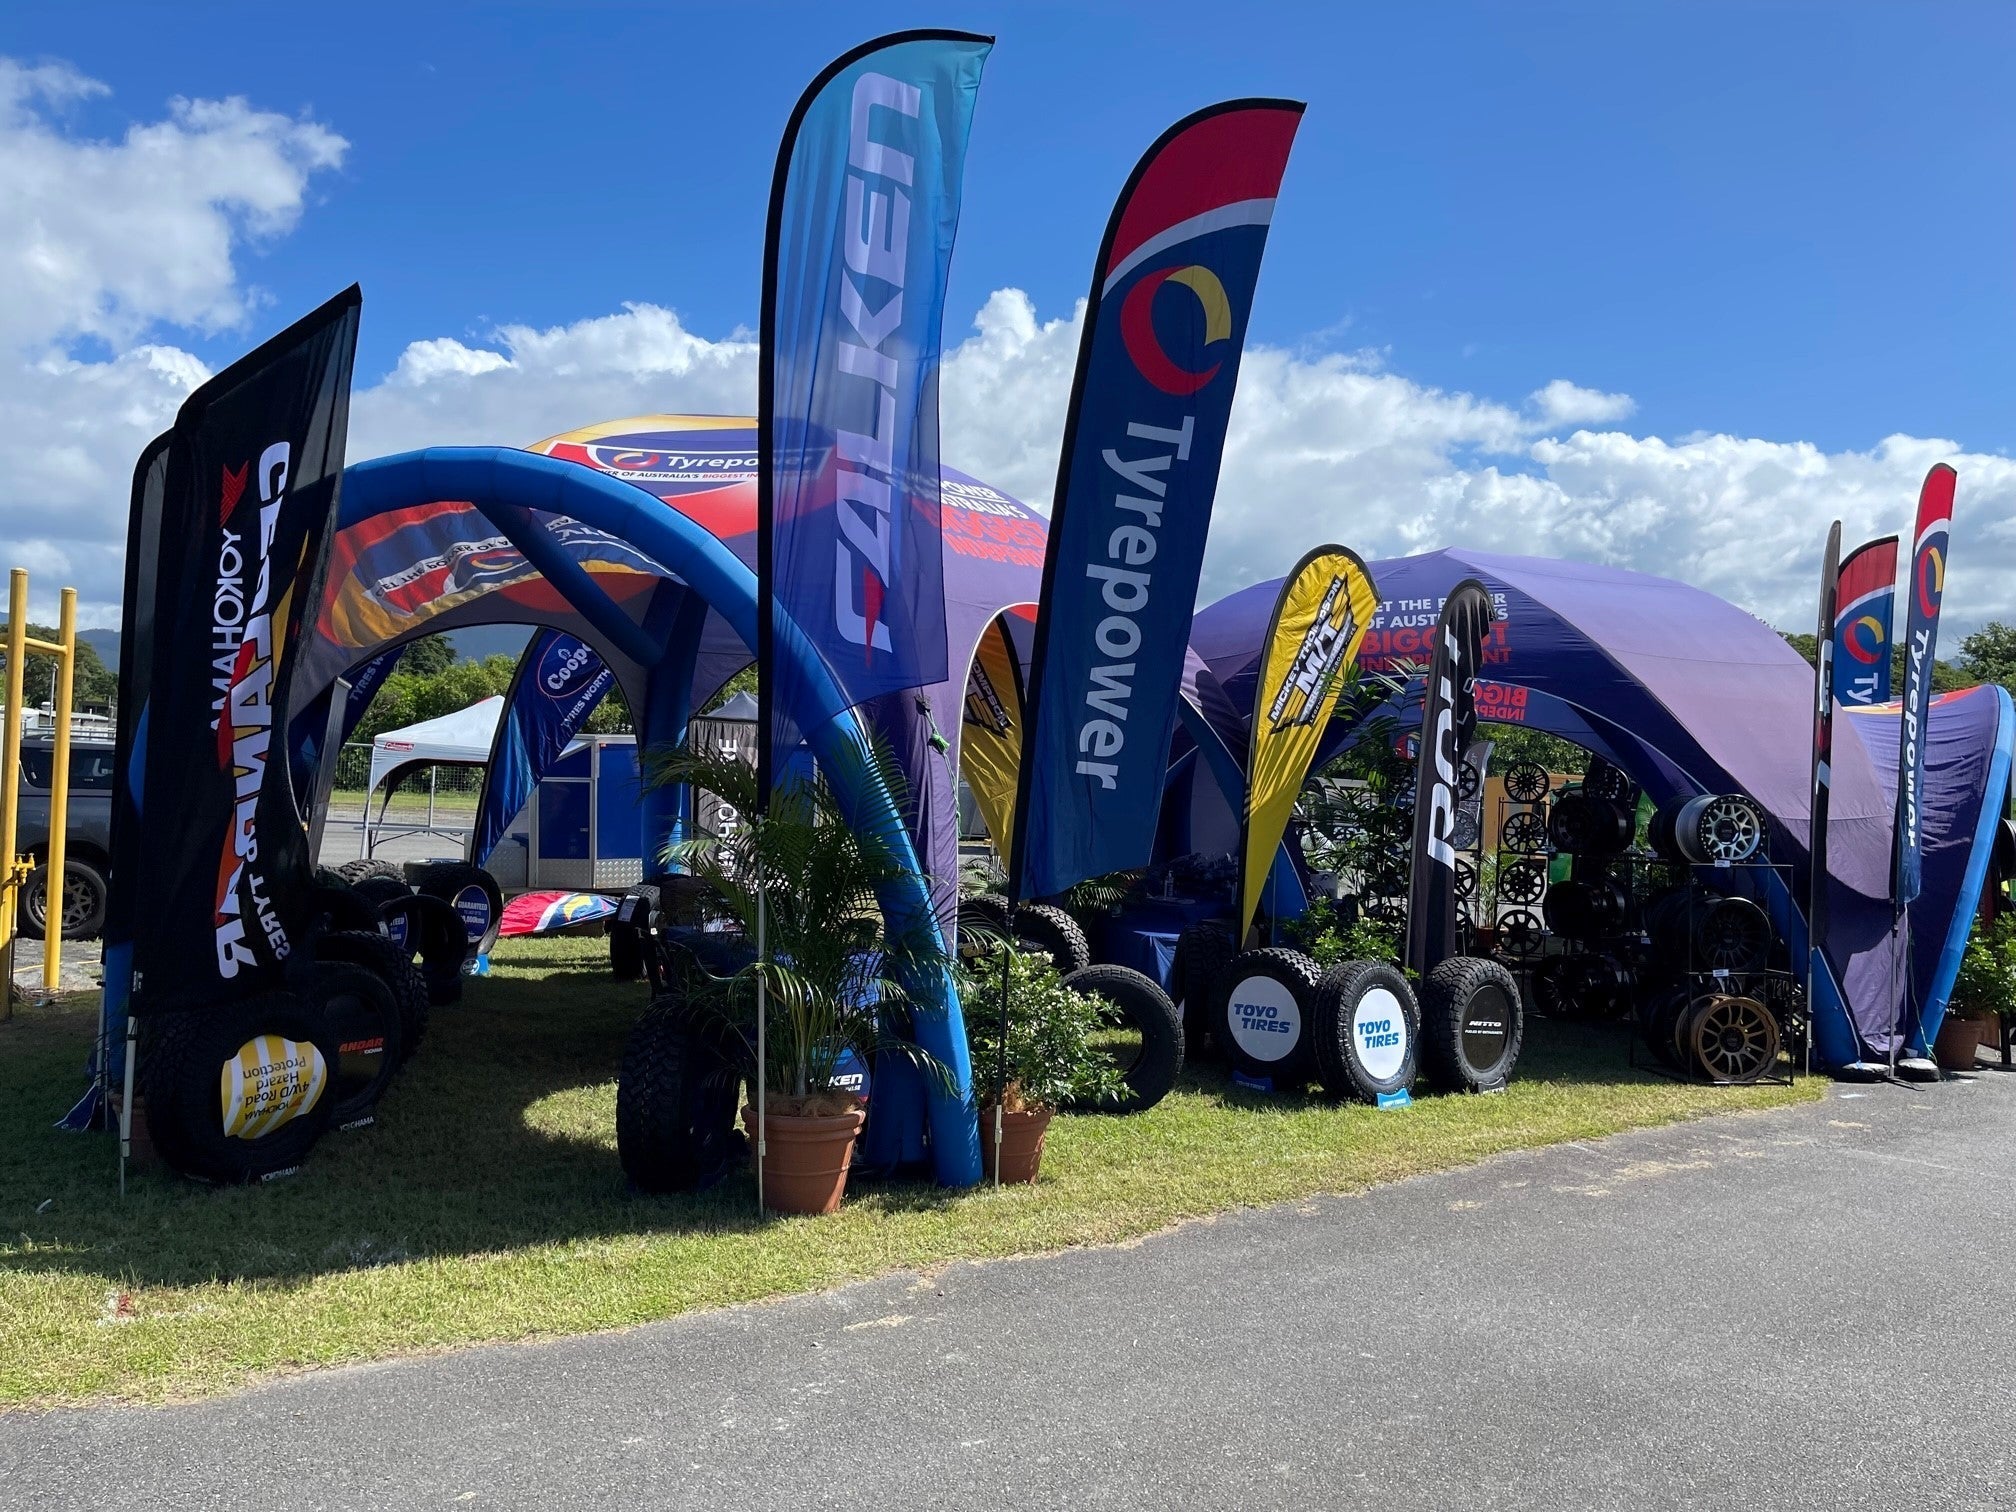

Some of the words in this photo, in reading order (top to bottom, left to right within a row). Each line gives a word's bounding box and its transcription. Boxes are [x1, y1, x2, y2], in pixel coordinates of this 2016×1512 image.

[940, 493, 1029, 520] STRALIA'S
[1075, 415, 1195, 790] Tyrepower
[1398, 598, 1432, 612] THE
[547, 643, 592, 690] Coop
[349, 665, 377, 701] TYRES
[582, 668, 611, 701] WORTH
[1270, 661, 1300, 721] MICKEY
[1233, 1003, 1278, 1019] TOYO
[1241, 1017, 1291, 1034] TIRES
[1358, 1019, 1391, 1036] TOYO
[338, 1037, 384, 1053] ANDAR
[1364, 1032, 1399, 1049] TIRES
[243, 1056, 307, 1079] Protection
[256, 1071, 299, 1092] Hazard
[828, 1073, 863, 1087] KEN
[280, 1082, 309, 1097] 4WD
[245, 1092, 277, 1108] Road
